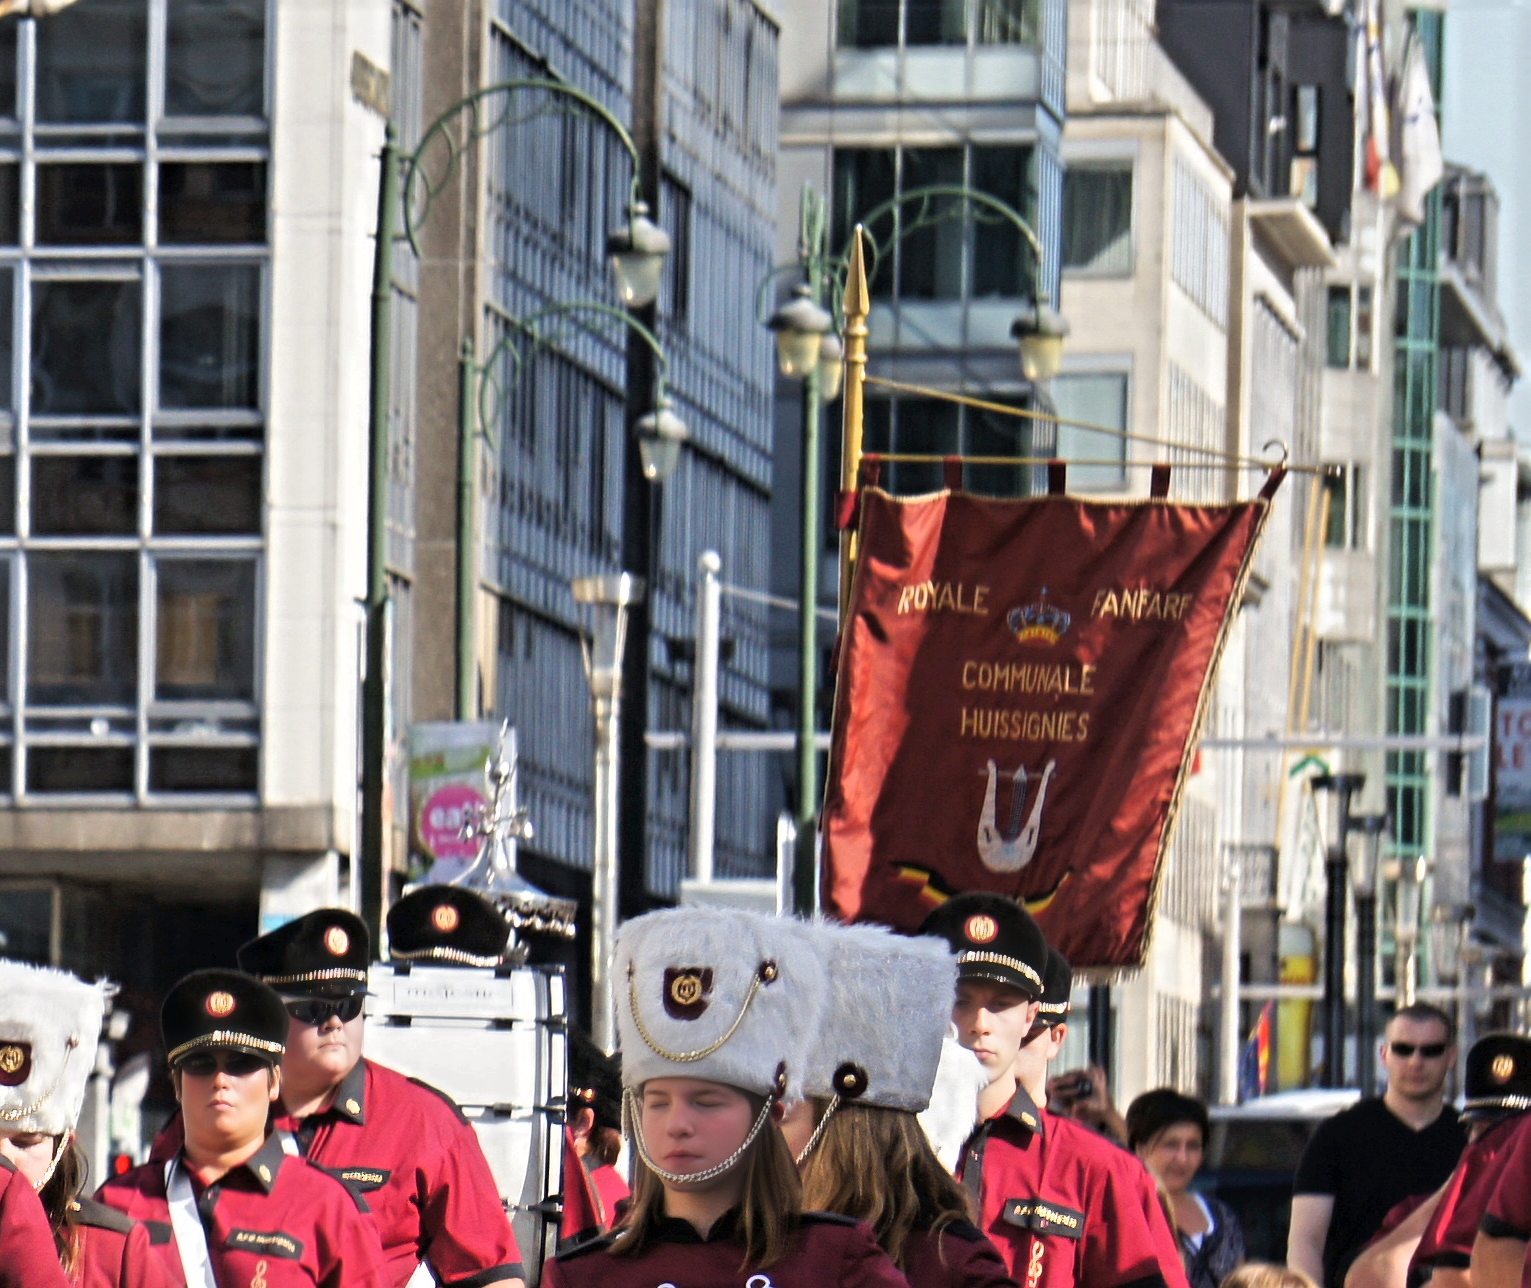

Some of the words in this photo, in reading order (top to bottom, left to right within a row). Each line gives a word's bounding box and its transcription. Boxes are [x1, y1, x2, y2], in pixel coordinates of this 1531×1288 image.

[898, 580, 989, 615] ROYALE
[962, 660, 1097, 694] COMMUNALE
[961, 707, 1090, 742] HUISSIGNIES
